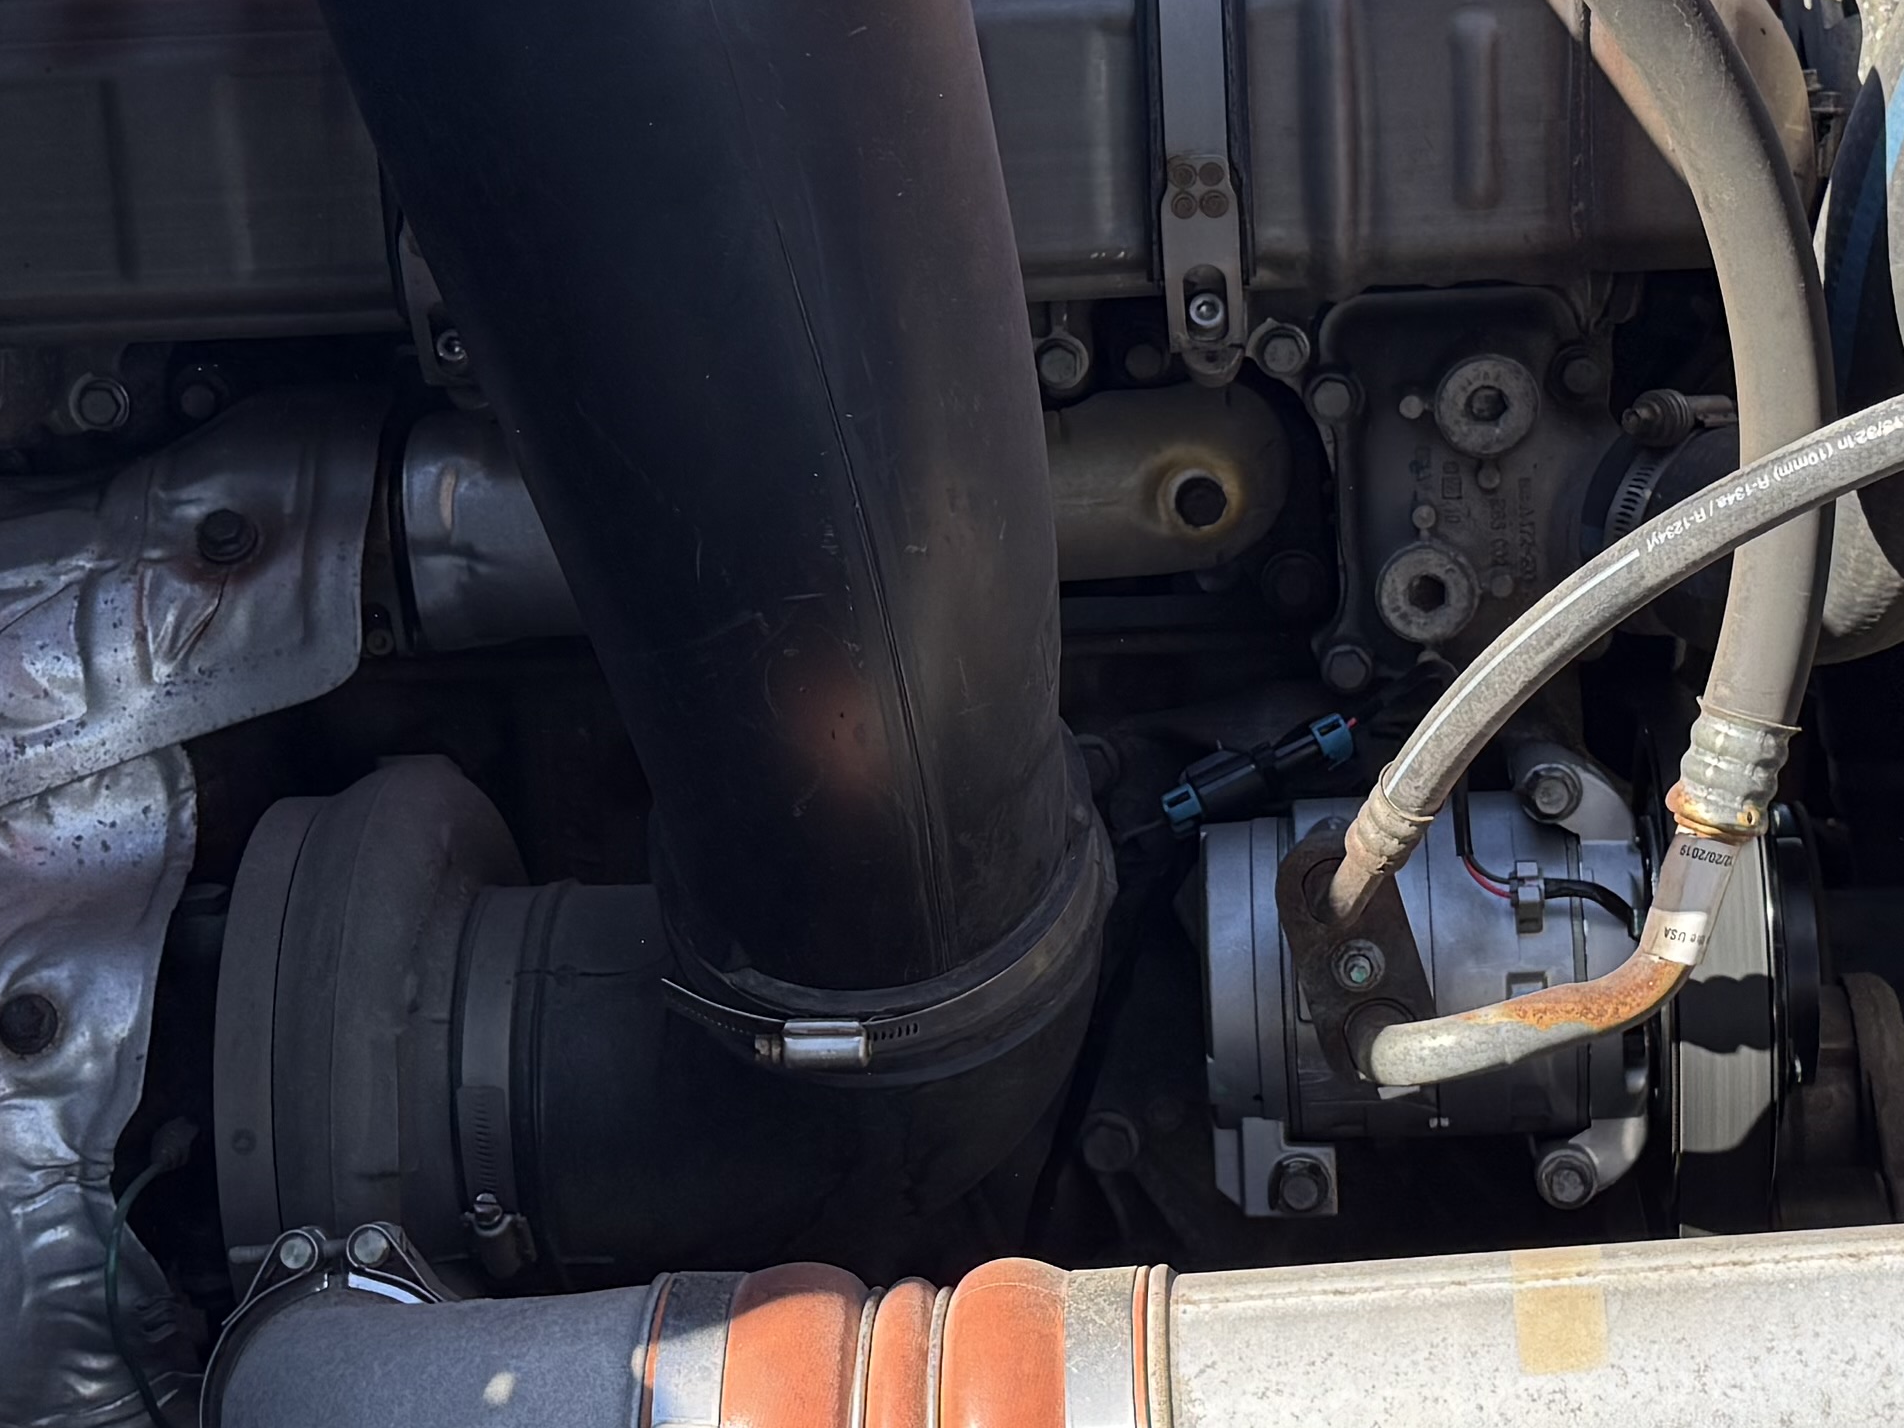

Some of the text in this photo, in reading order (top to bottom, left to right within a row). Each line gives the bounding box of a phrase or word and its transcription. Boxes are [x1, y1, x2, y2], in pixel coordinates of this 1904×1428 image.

[1770, 438, 1836, 483] (10mm)
[1713, 471, 1771, 509] R-134a
[1664, 926, 1687, 944] USA
